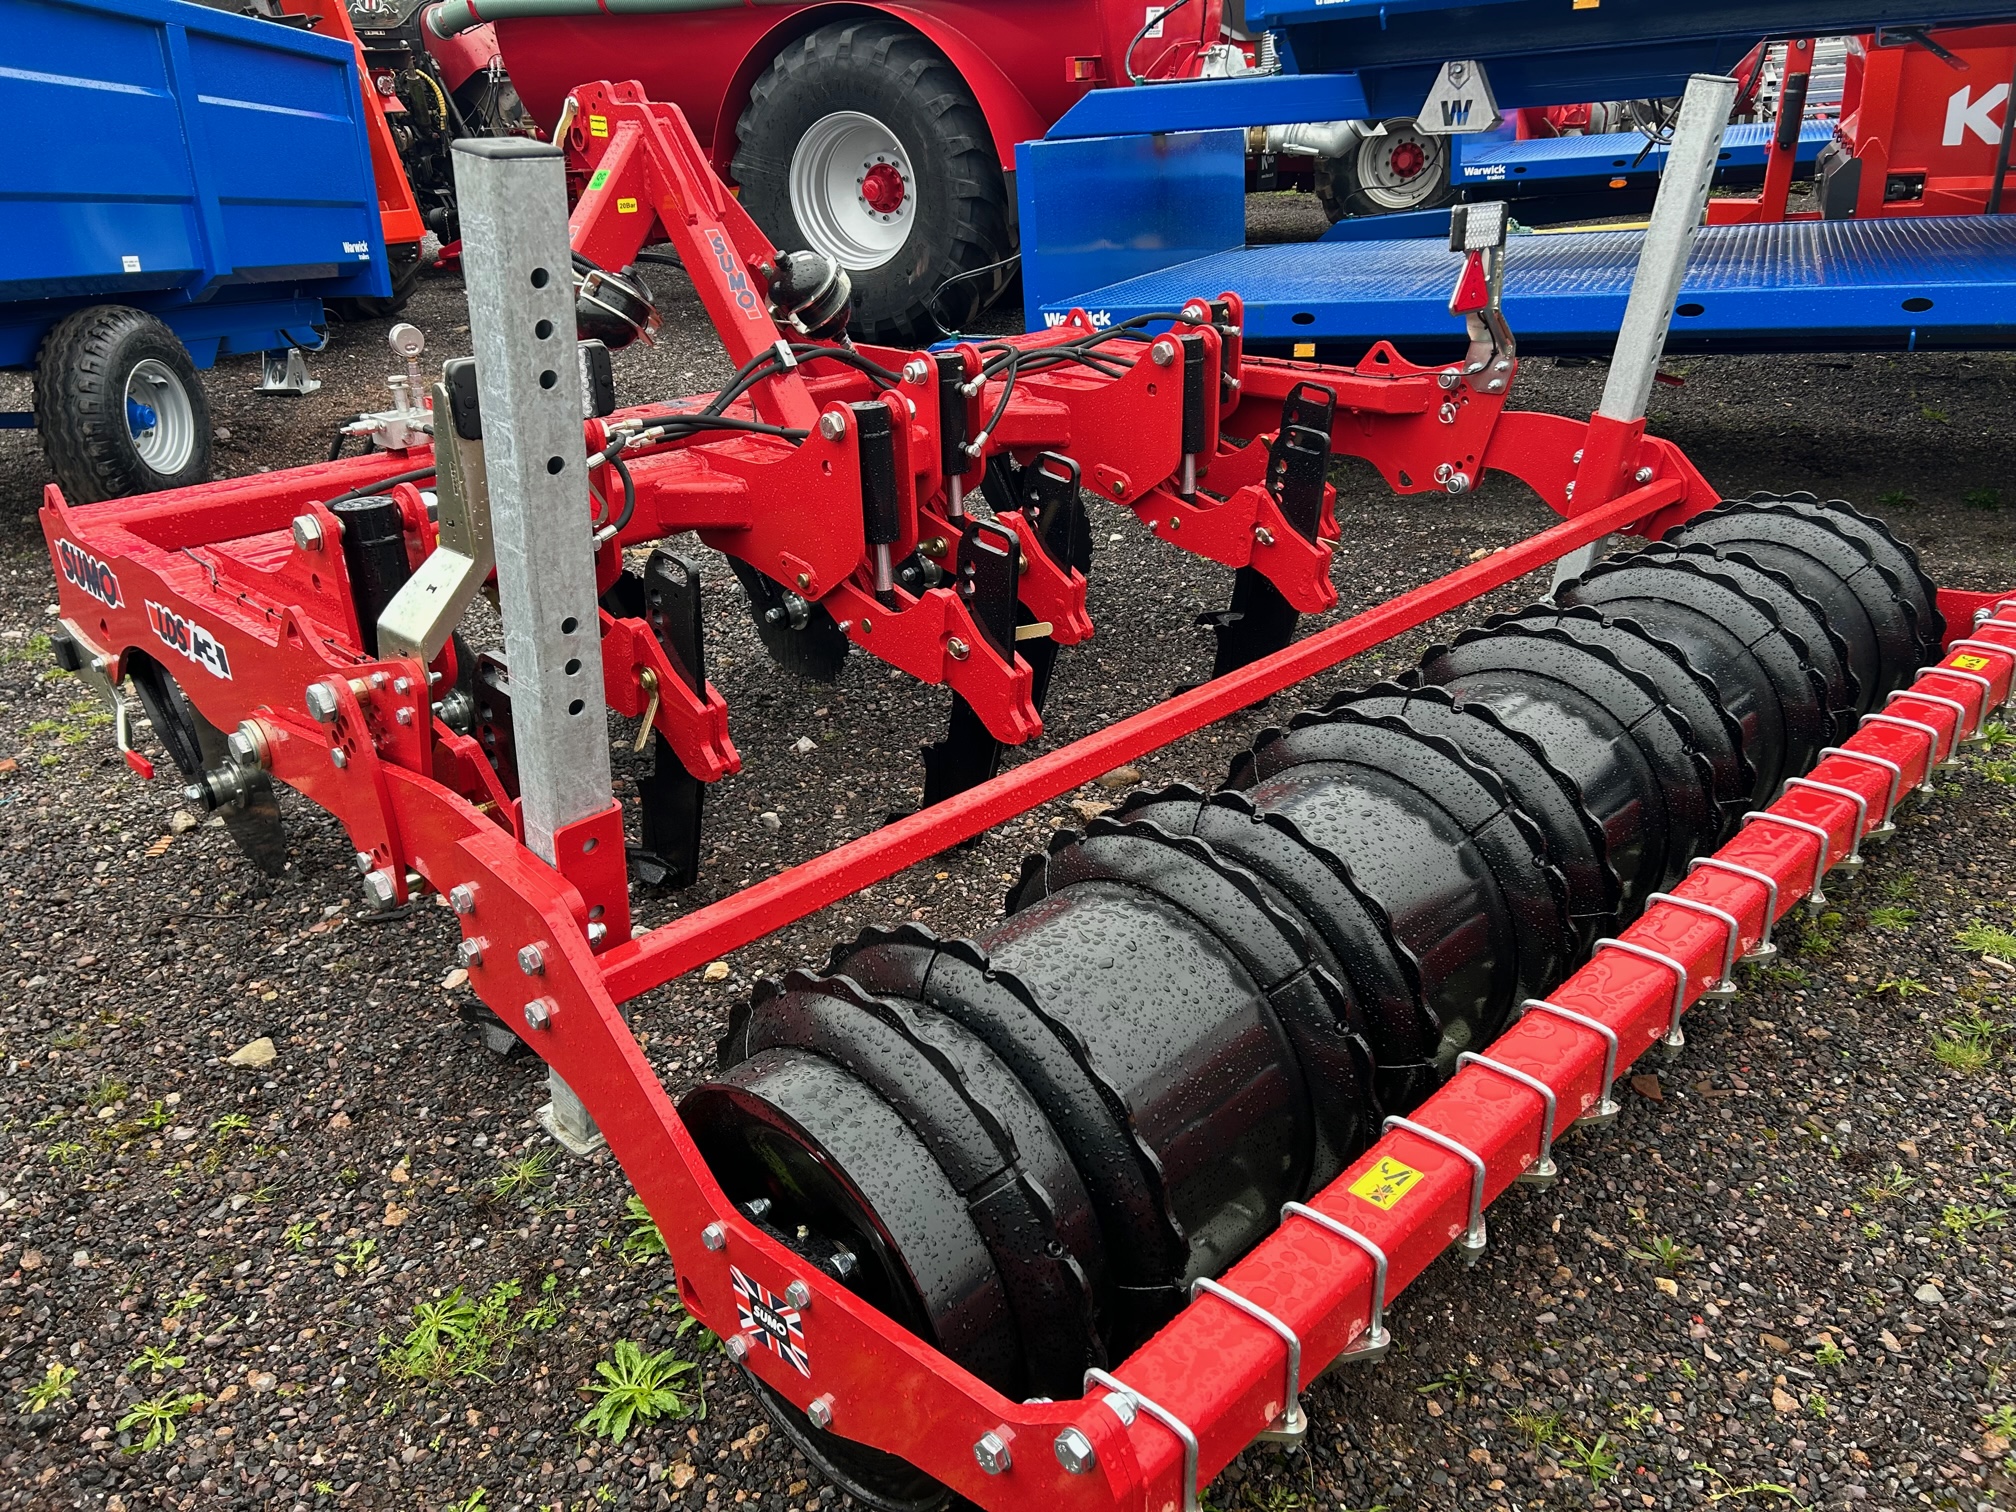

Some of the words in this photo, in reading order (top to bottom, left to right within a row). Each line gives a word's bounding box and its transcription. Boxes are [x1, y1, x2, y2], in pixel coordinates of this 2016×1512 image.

[1440, 99, 1474, 126] W
[1942, 83, 2016, 146] K
[1463, 164, 1506, 177] Warwick
[619, 202, 636, 210] 20Bar
[342, 239, 369, 254] Warwick
[711, 235, 756, 310] SUMO
[1043, 309, 1112, 328] Waick
[60, 540, 118, 607] SUMO
[752, 1304, 787, 1337] SUMO
